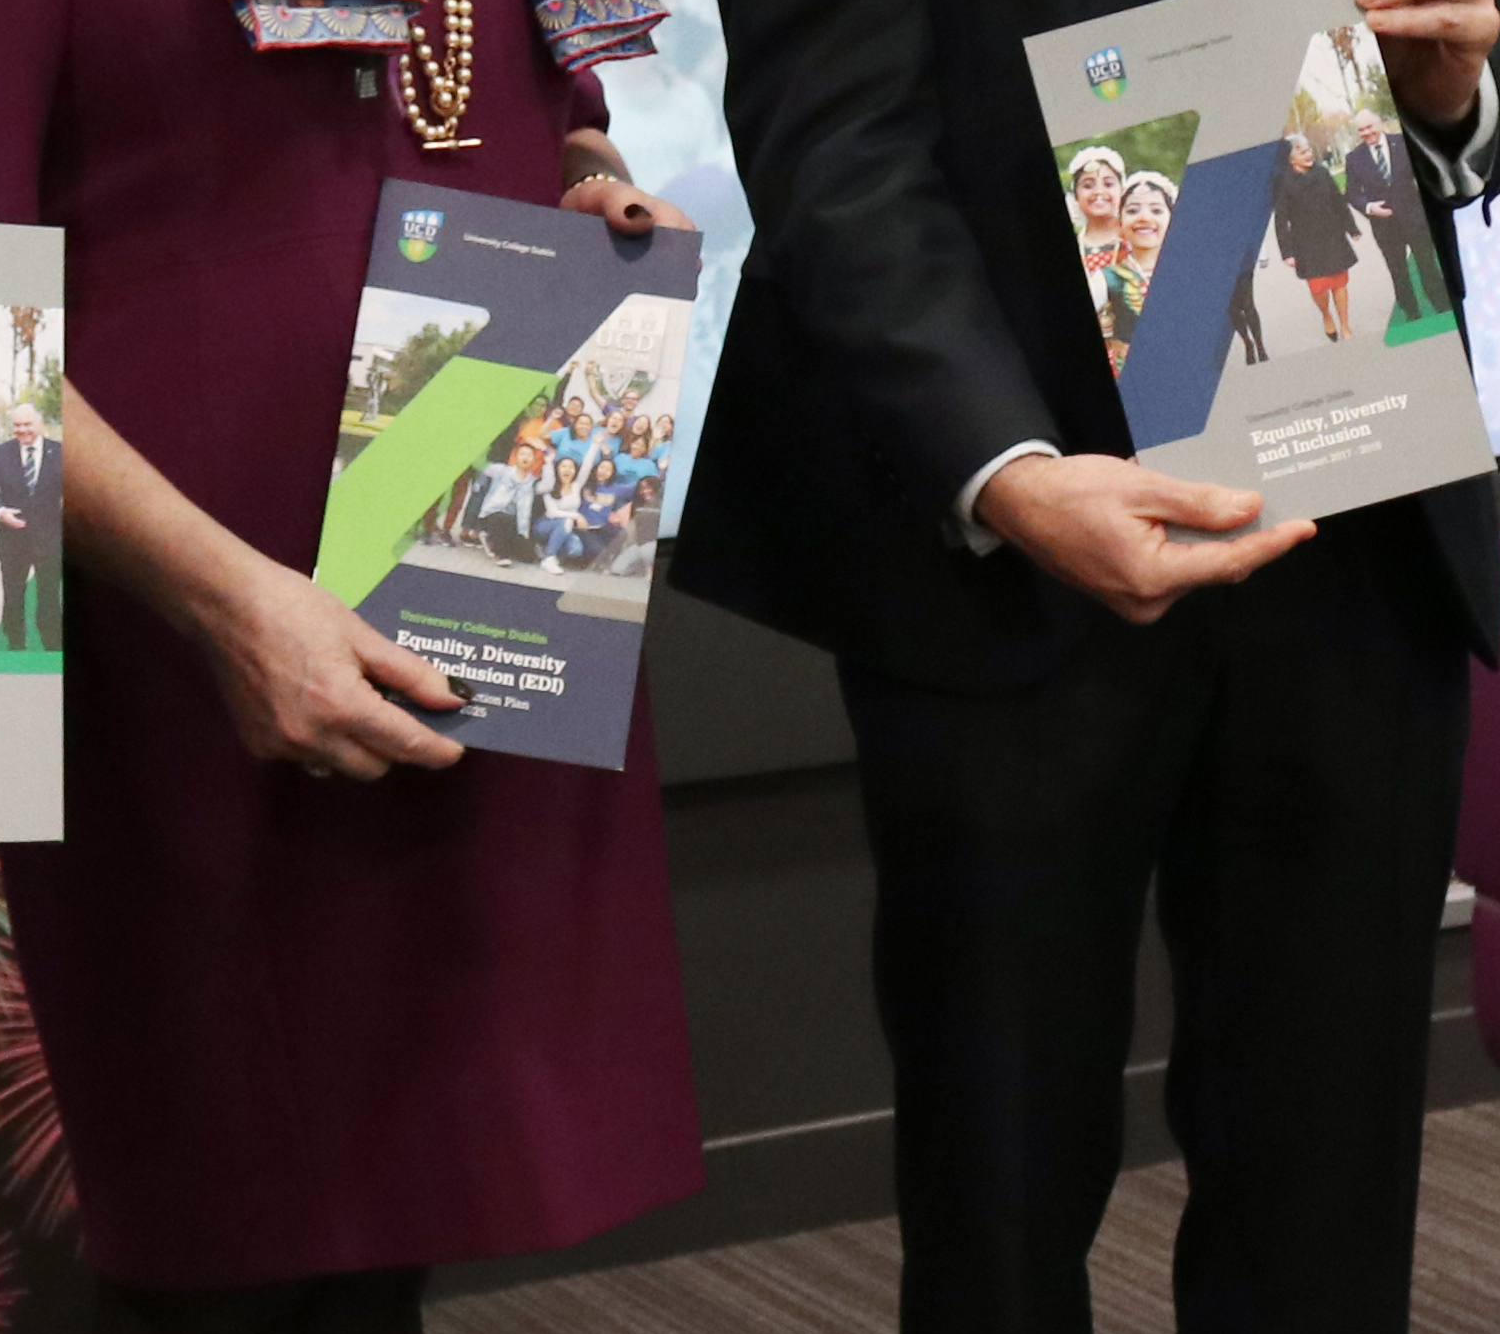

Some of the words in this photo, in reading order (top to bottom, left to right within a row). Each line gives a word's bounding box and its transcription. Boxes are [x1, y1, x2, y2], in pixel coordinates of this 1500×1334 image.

[1090, 61, 1121, 78] UCD
[404, 222, 438, 237] UCD
[597, 328, 654, 352] UCD
[1250, 416, 1329, 447] Equality,
[1330, 393, 1408, 425] Diversity
[1256, 441, 1291, 465] and
[1293, 423, 1372, 455] Inclusion
[396, 630, 477, 661] Equality,
[481, 644, 567, 675] Diversity
[518, 672, 566, 696] (EDI)
